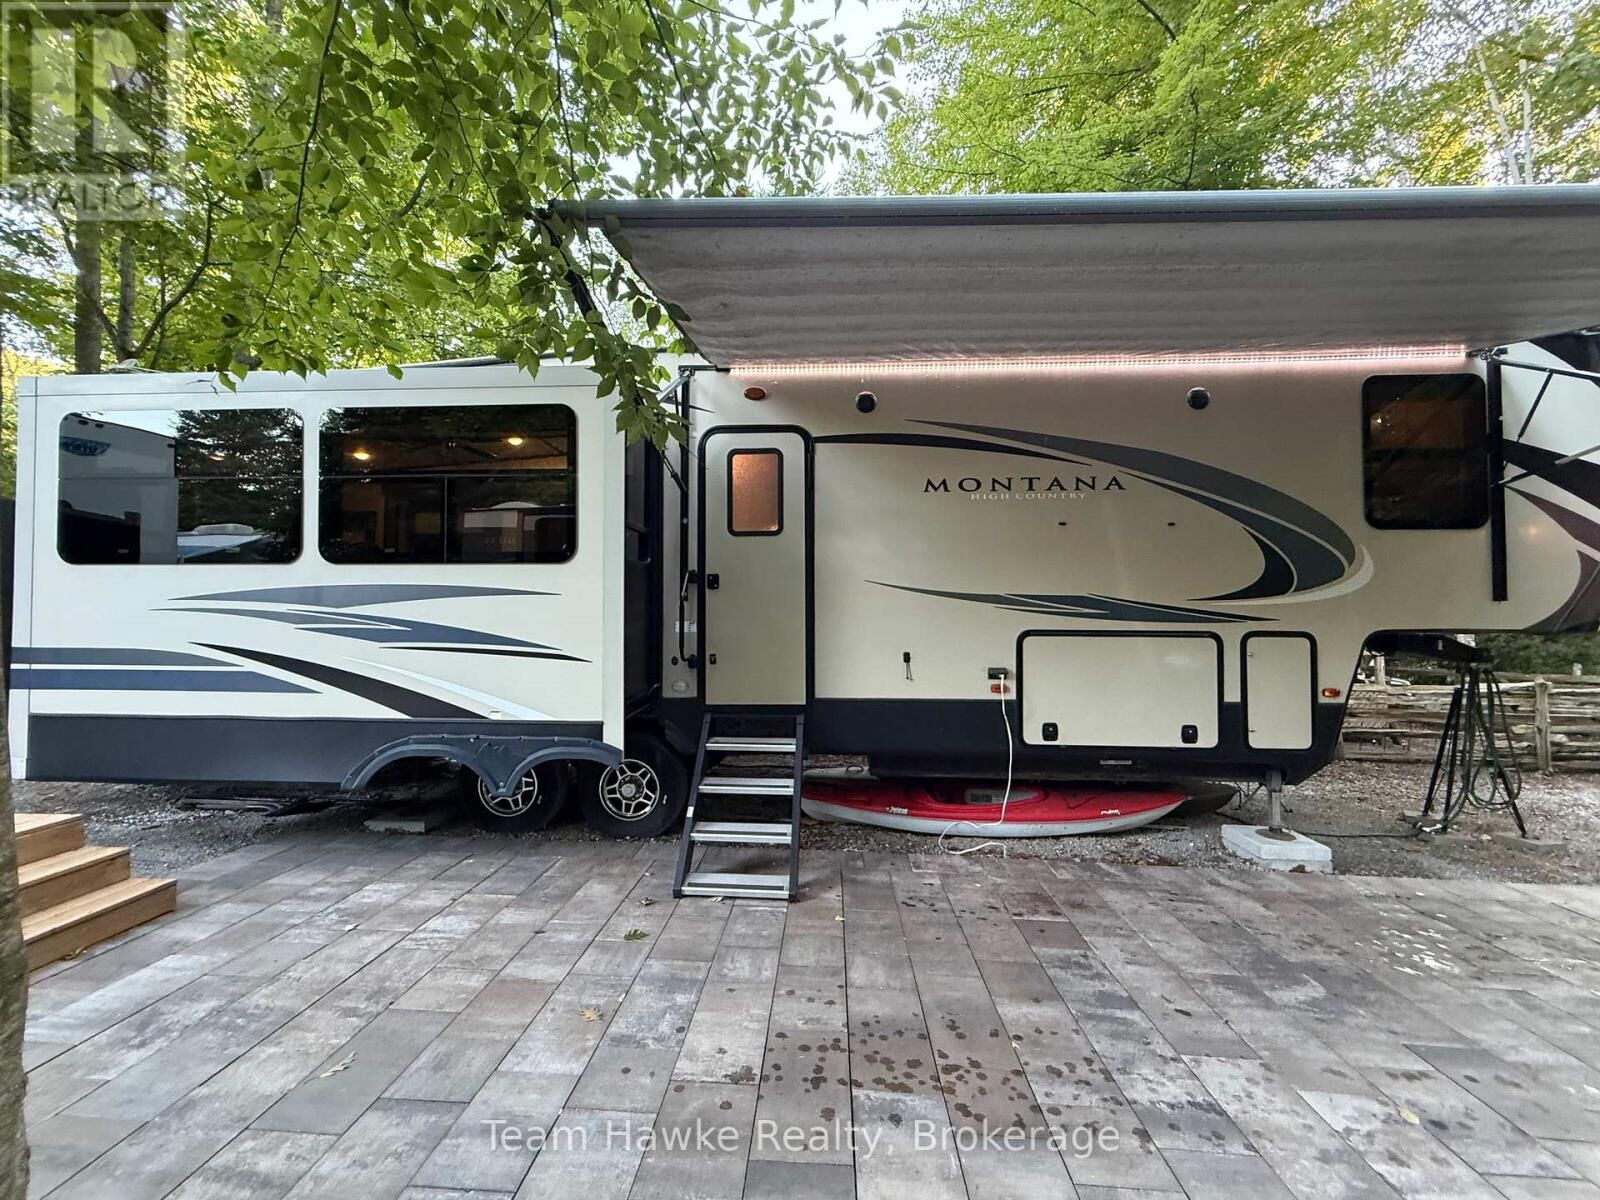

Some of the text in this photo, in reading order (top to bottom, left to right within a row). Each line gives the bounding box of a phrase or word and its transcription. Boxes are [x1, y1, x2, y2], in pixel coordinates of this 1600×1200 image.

[923, 475, 1126, 493] MONTANA
[970, 491, 1087, 501] HIGH COUNTRY
